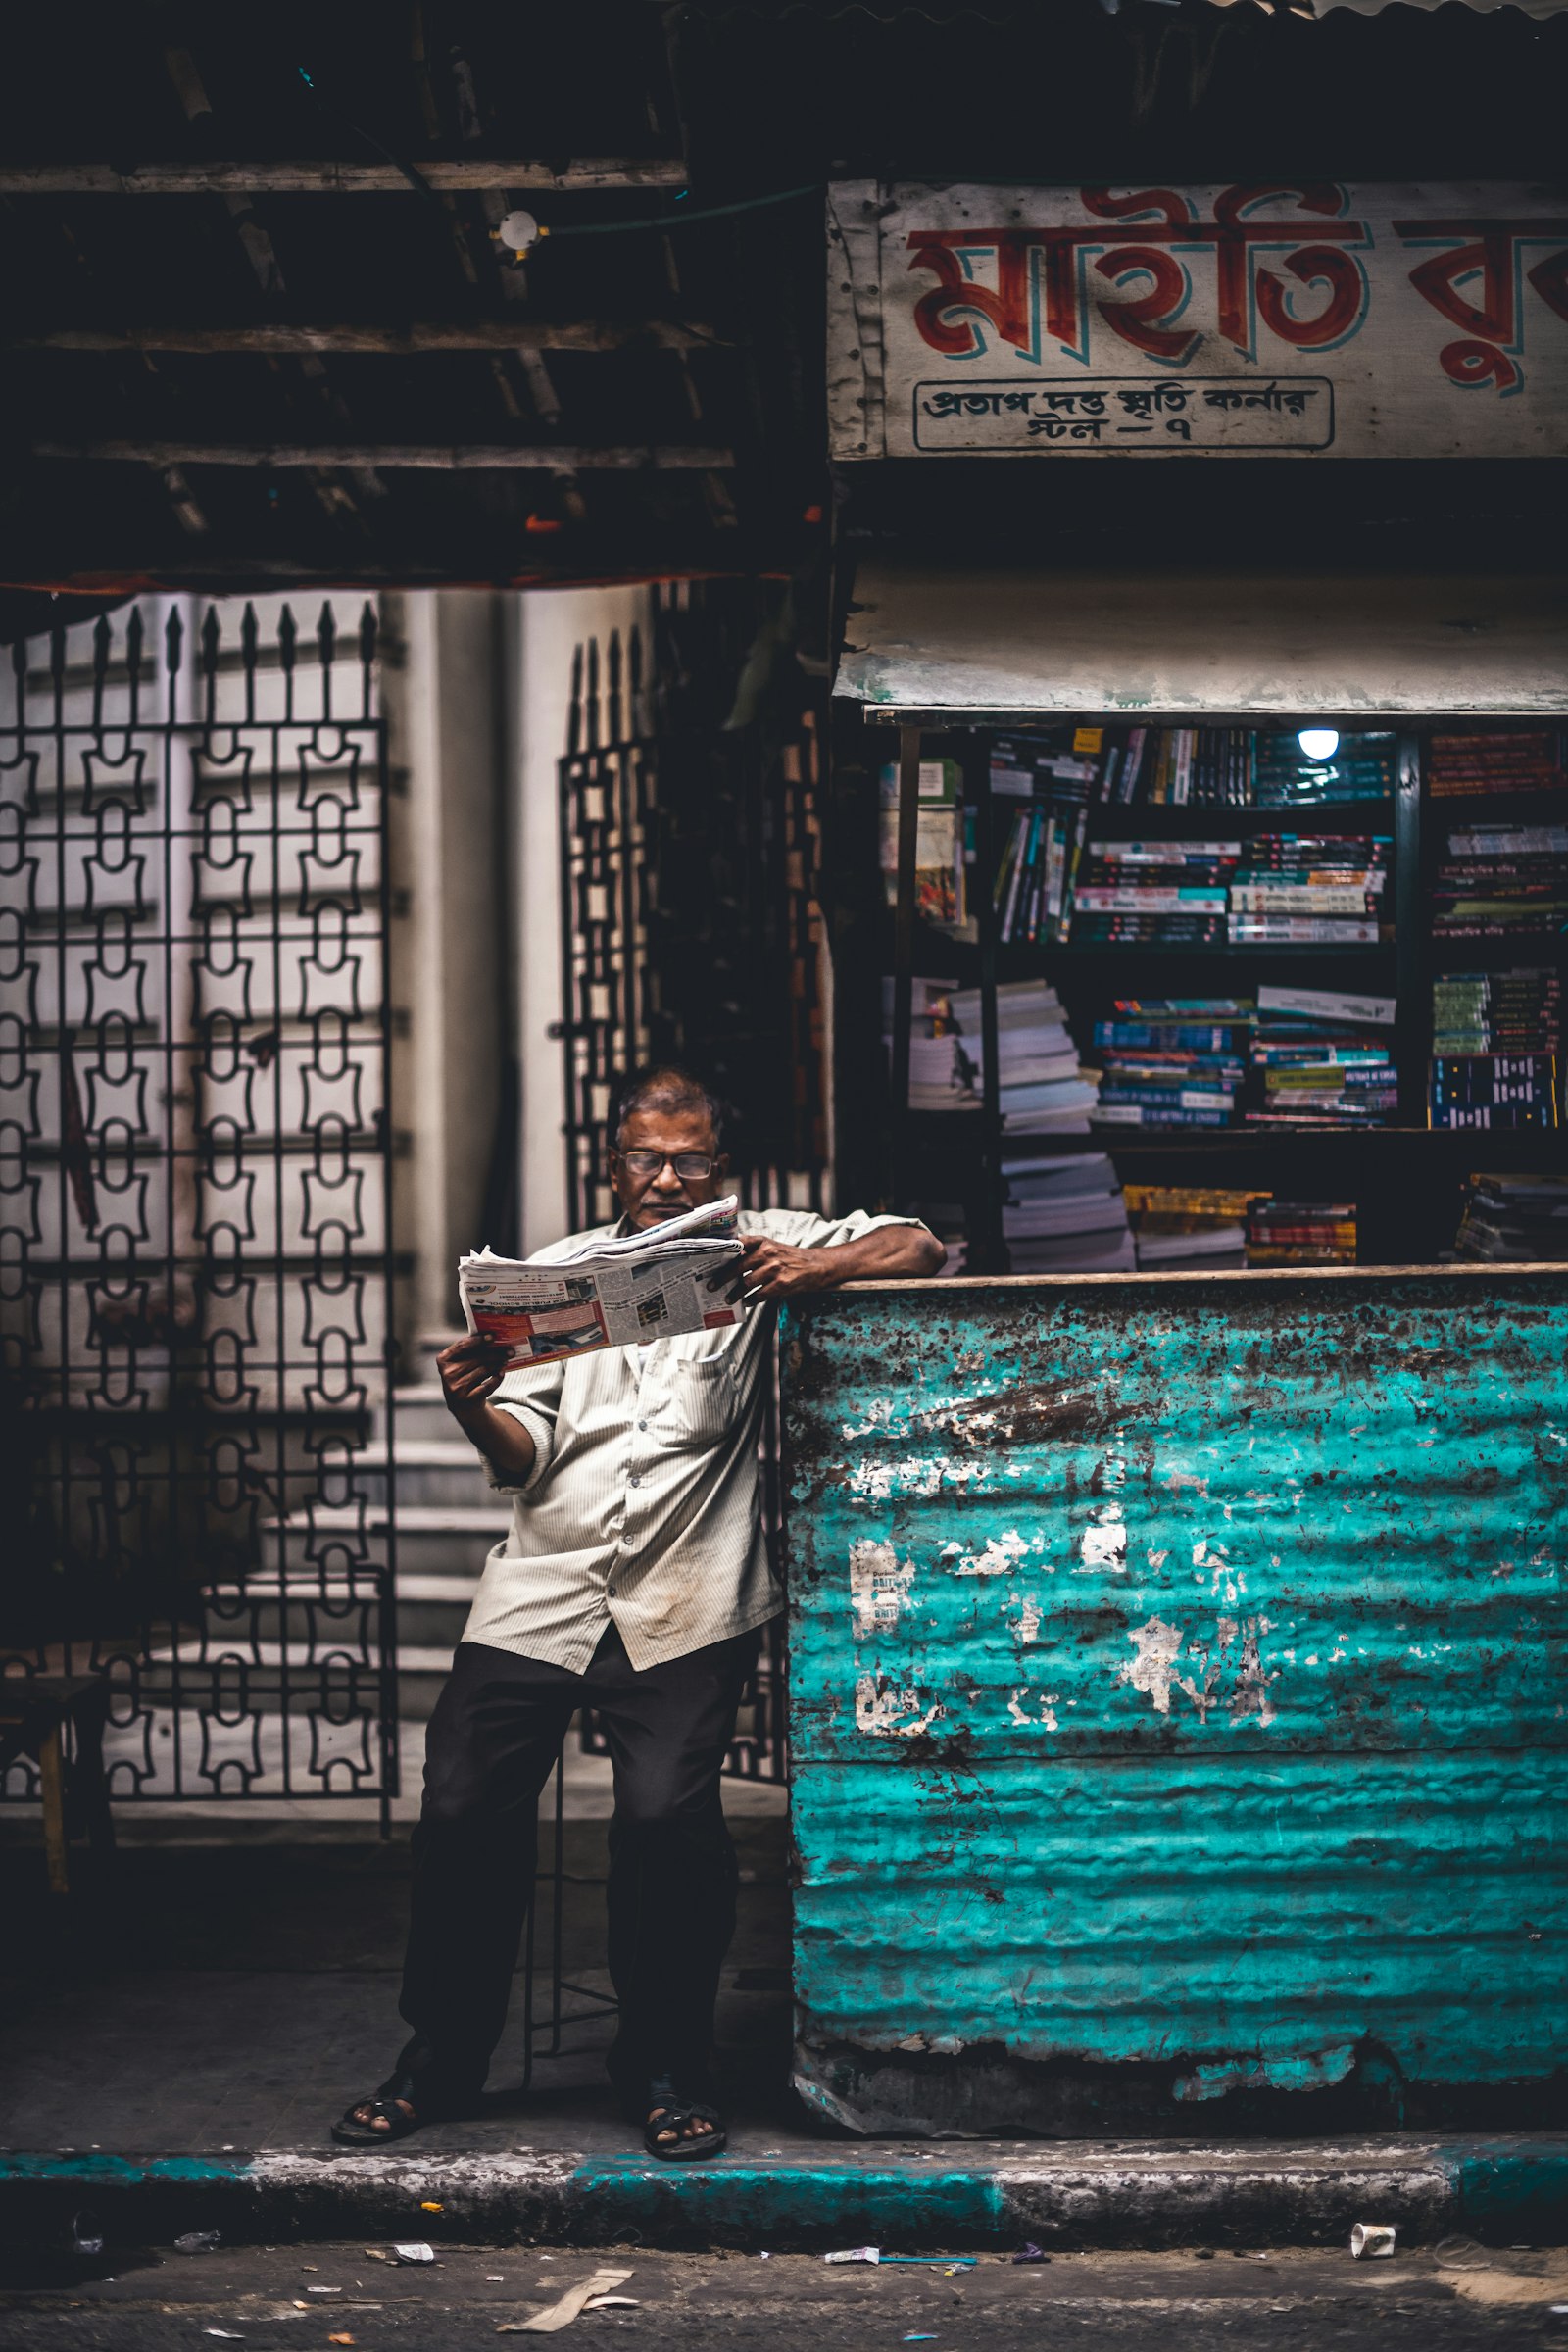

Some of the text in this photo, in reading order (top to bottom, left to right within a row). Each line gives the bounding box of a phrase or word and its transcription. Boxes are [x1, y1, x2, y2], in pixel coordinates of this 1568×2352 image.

[907, 182, 1372, 365] মাইতি
[923, 391, 1036, 417] প্রতাপ
[1117, 382, 1195, 419] স্মৃতি
[1203, 382, 1319, 417] কর্নার
[1027, 412, 1110, 440] স্টল
[1165, 418, 1192, 440] ৭
